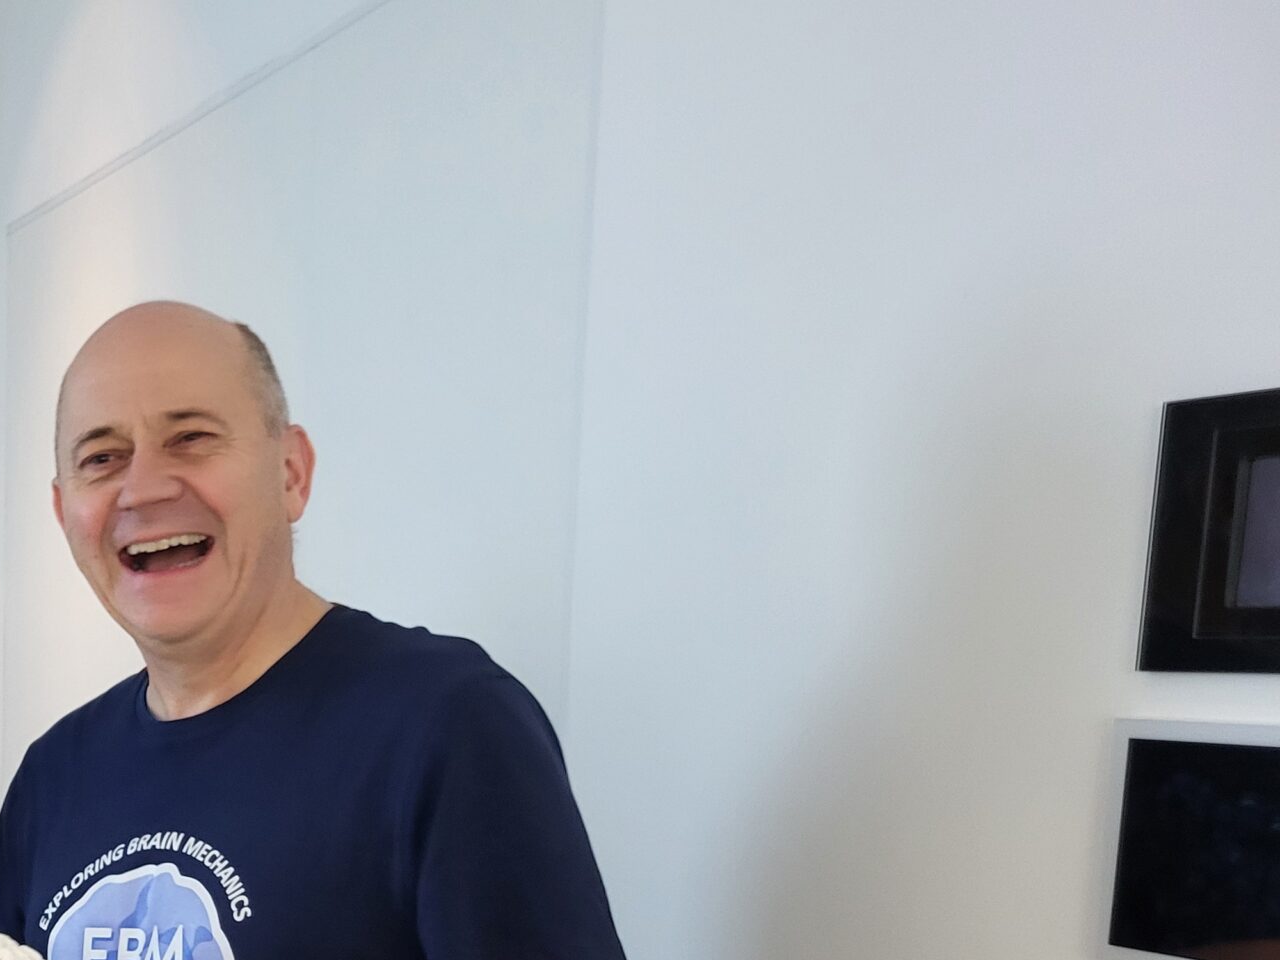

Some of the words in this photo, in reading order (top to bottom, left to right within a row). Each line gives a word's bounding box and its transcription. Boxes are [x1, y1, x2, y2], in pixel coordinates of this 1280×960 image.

[39, 844, 125, 931] EXPLORING
[127, 832, 184, 855] BRAIN
[182, 836, 252, 922] MECHANICS
